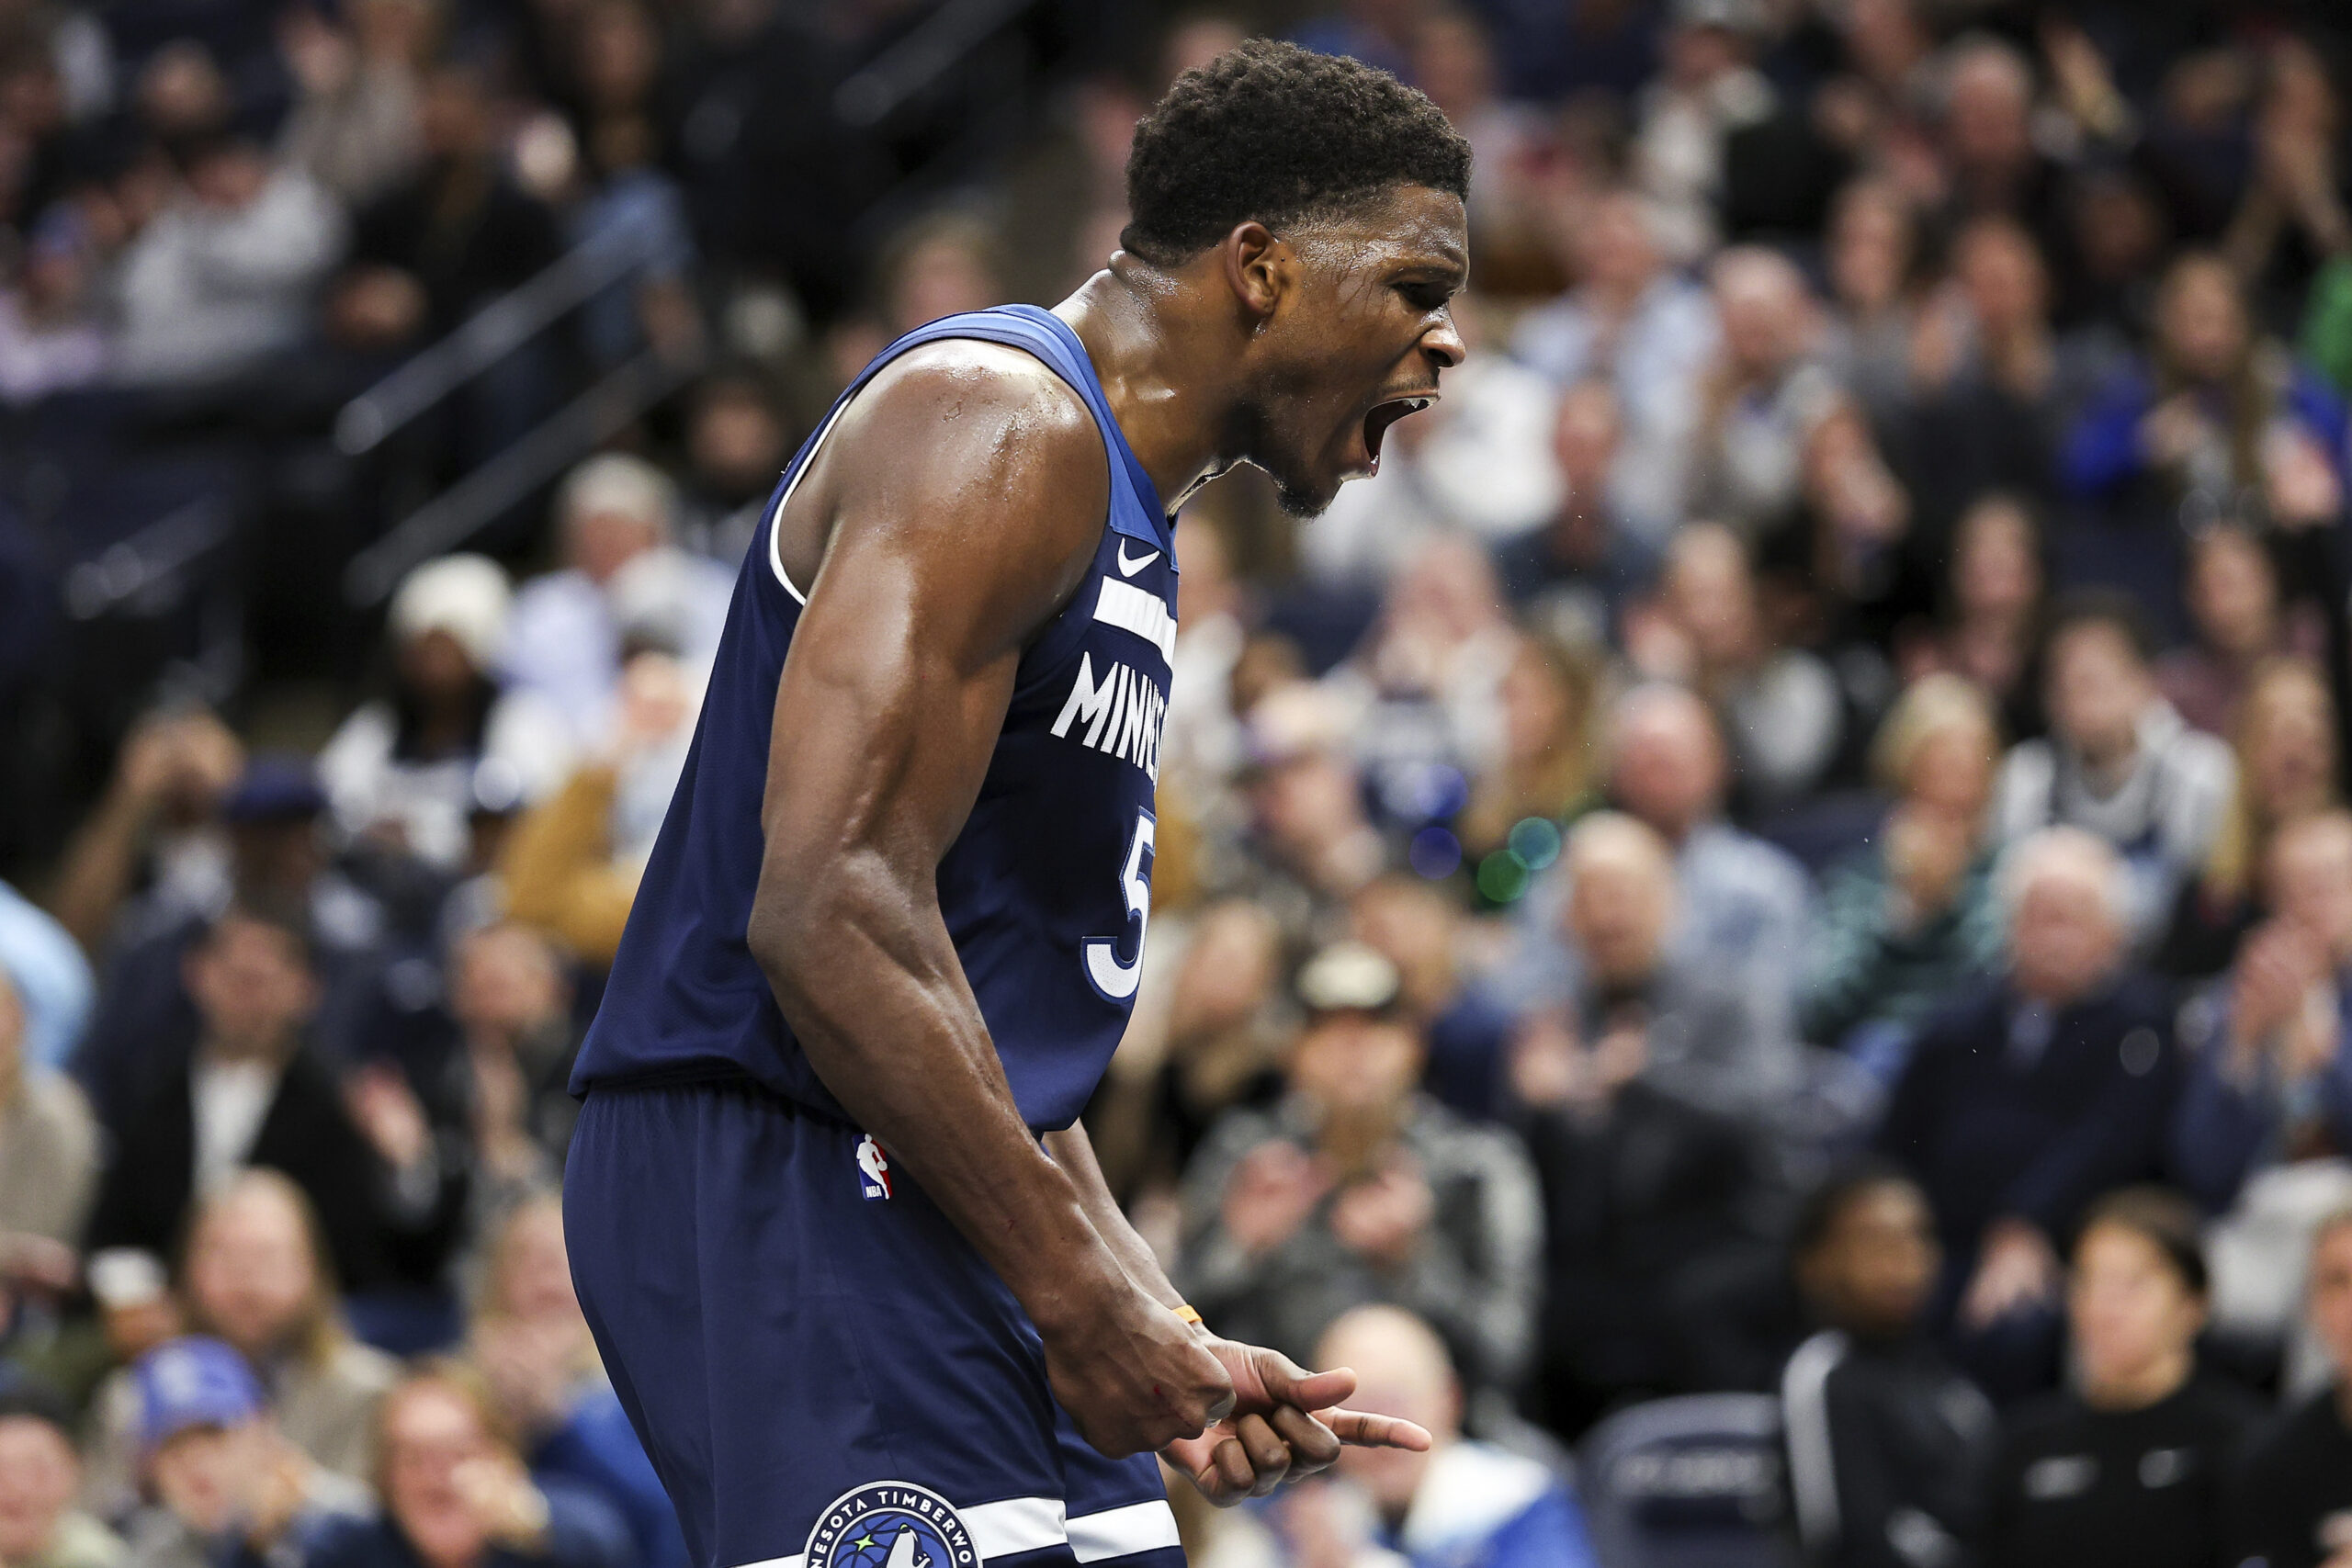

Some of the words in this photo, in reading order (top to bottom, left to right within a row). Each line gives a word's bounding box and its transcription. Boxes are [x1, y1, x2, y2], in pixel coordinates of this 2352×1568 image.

[1049, 650, 1169, 794] MINNES
[1081, 806, 1158, 1004] 5
[865, 1184, 883, 1199] NBA
